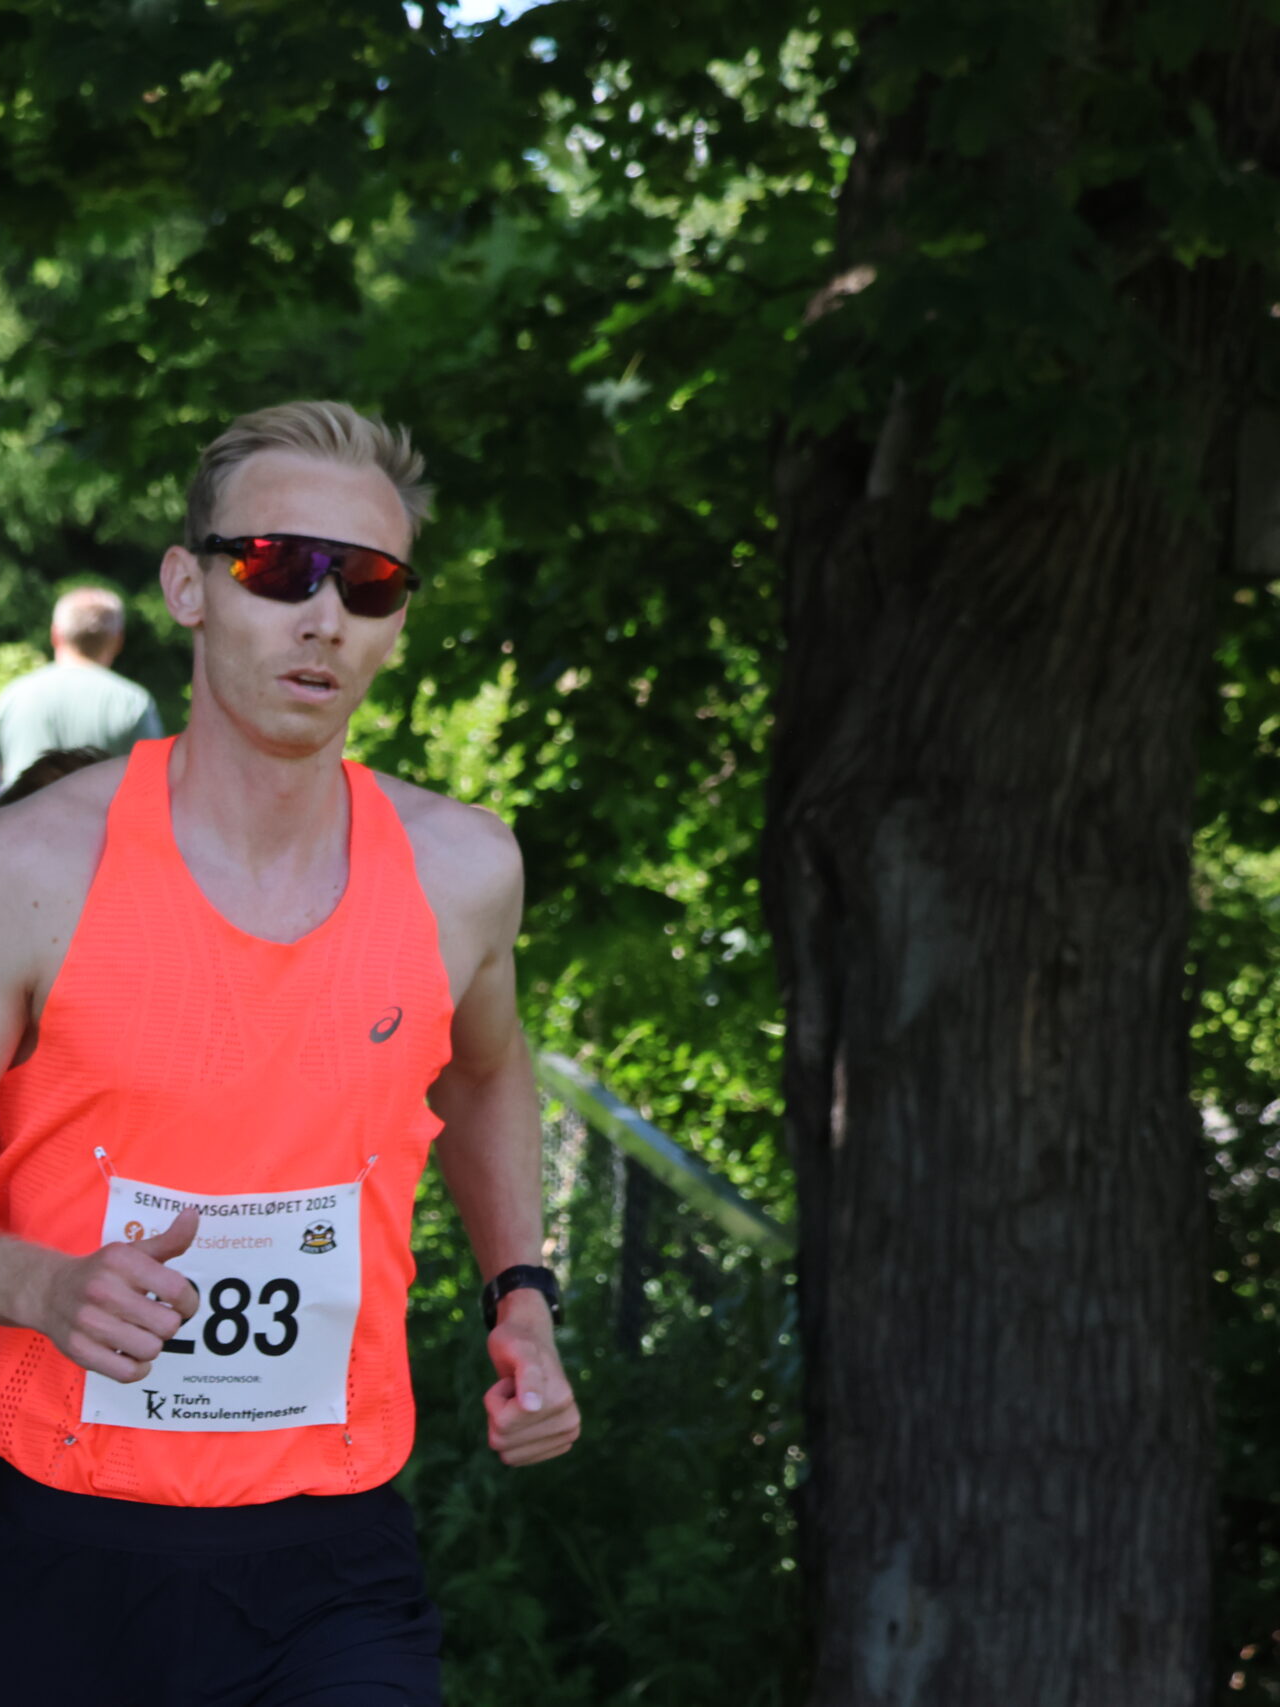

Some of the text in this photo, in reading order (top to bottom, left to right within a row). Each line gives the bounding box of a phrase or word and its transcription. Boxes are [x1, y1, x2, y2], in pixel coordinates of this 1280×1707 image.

[306, 1195, 336, 1211] 2025
[183, 1375, 262, 1384] HOVEDSPONSOR:
[171, 1404, 308, 1422] Konsulenttjenester
